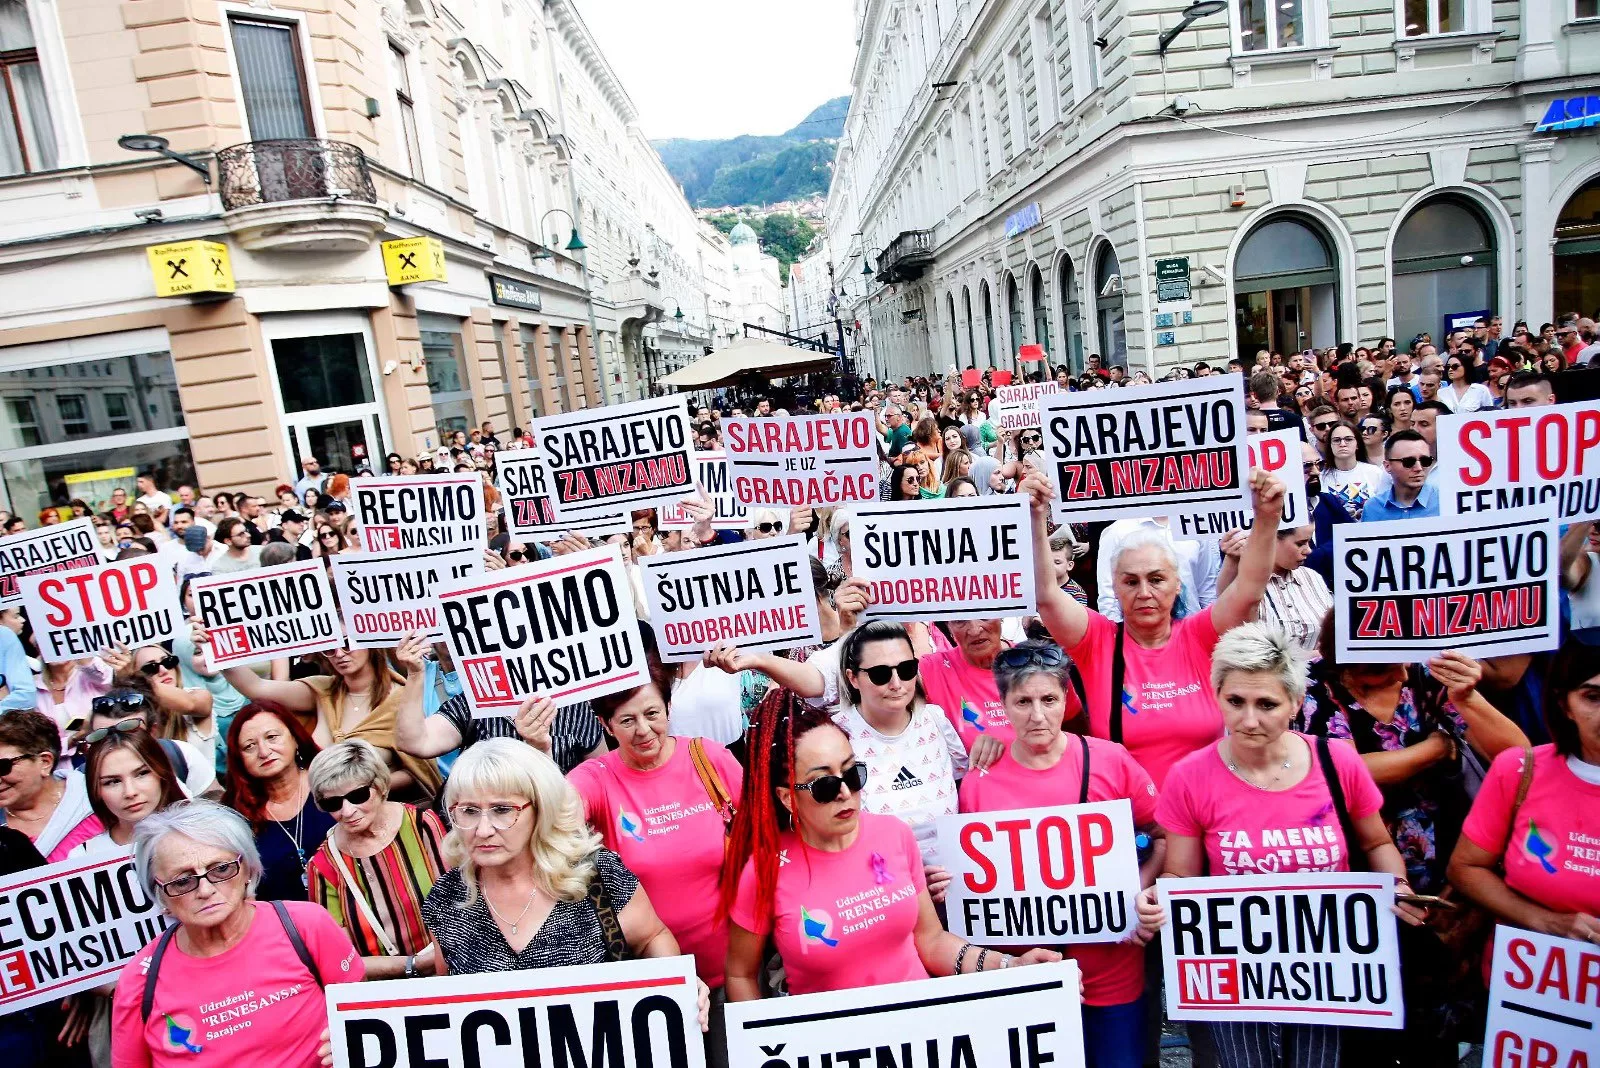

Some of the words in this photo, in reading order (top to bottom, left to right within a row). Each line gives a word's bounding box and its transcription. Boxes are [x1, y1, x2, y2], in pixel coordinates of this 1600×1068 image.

[727, 416, 870, 453] SARAJEVO
[1000, 412, 1042, 428] GRADA
[1050, 399, 1236, 459] SARAJEVO
[543, 414, 685, 469] SARAJEVO
[1458, 409, 1600, 487] STOP
[559, 472, 594, 501] ZA
[595, 454, 687, 498] NIZAMU
[785, 458, 798, 471] JE
[801, 457, 817, 470] UZ
[1064, 464, 1106, 499] ZA
[1112, 450, 1232, 496] NIZAMU
[358, 484, 476, 525] RECIMO
[736, 470, 875, 506] GRADAČAC
[514, 500, 541, 526] ZA
[369, 528, 396, 552] NE
[864, 524, 978, 569] ŠUTNJA
[988, 524, 1020, 563] JE
[1344, 530, 1548, 593] SARAJEVO
[38, 562, 158, 628] STOP
[198, 573, 323, 628] RECIMO
[656, 567, 764, 613] ŠUTNJA
[774, 561, 802, 597] JE
[865, 572, 1023, 605] ODOBRAVANJE
[353, 607, 441, 634] ODOBRAV
[442, 568, 620, 656] RECIMO
[664, 604, 809, 646] ODOBRAVANJE
[1357, 600, 1402, 637] ZA
[1412, 586, 1541, 637] NIZAMU
[48, 608, 173, 657] FEMICIDU
[213, 628, 247, 657] NE
[247, 613, 333, 649] NASILJU
[467, 661, 508, 700] NE
[505, 630, 634, 695] NASILJU
[1142, 702, 1173, 710] Sarajevo
[892, 778, 924, 791] adidas
[643, 801, 681, 815] Udruženje
[647, 824, 680, 836] Sarajevo
[1217, 830, 1253, 849] ZA
[1262, 825, 1338, 848] MENE
[1568, 831, 1600, 846] Udru
[959, 812, 1114, 894] STOP
[1220, 850, 1256, 869] ZA
[1277, 844, 1341, 867] TEBE
[836, 886, 885, 908] Udruženje
[962, 890, 1128, 937] FEMICIDU
[842, 913, 886, 935] Sarajevo
[1170, 892, 1380, 956] RECIMO
[0, 956, 27, 996] E
[1184, 962, 1231, 1001] NE
[1240, 961, 1388, 1005] NASILJU
[200, 989, 255, 1014] Udruženje
[202, 984, 303, 1027] "RENESANSA"
[206, 1020, 252, 1041] Sarajevo
